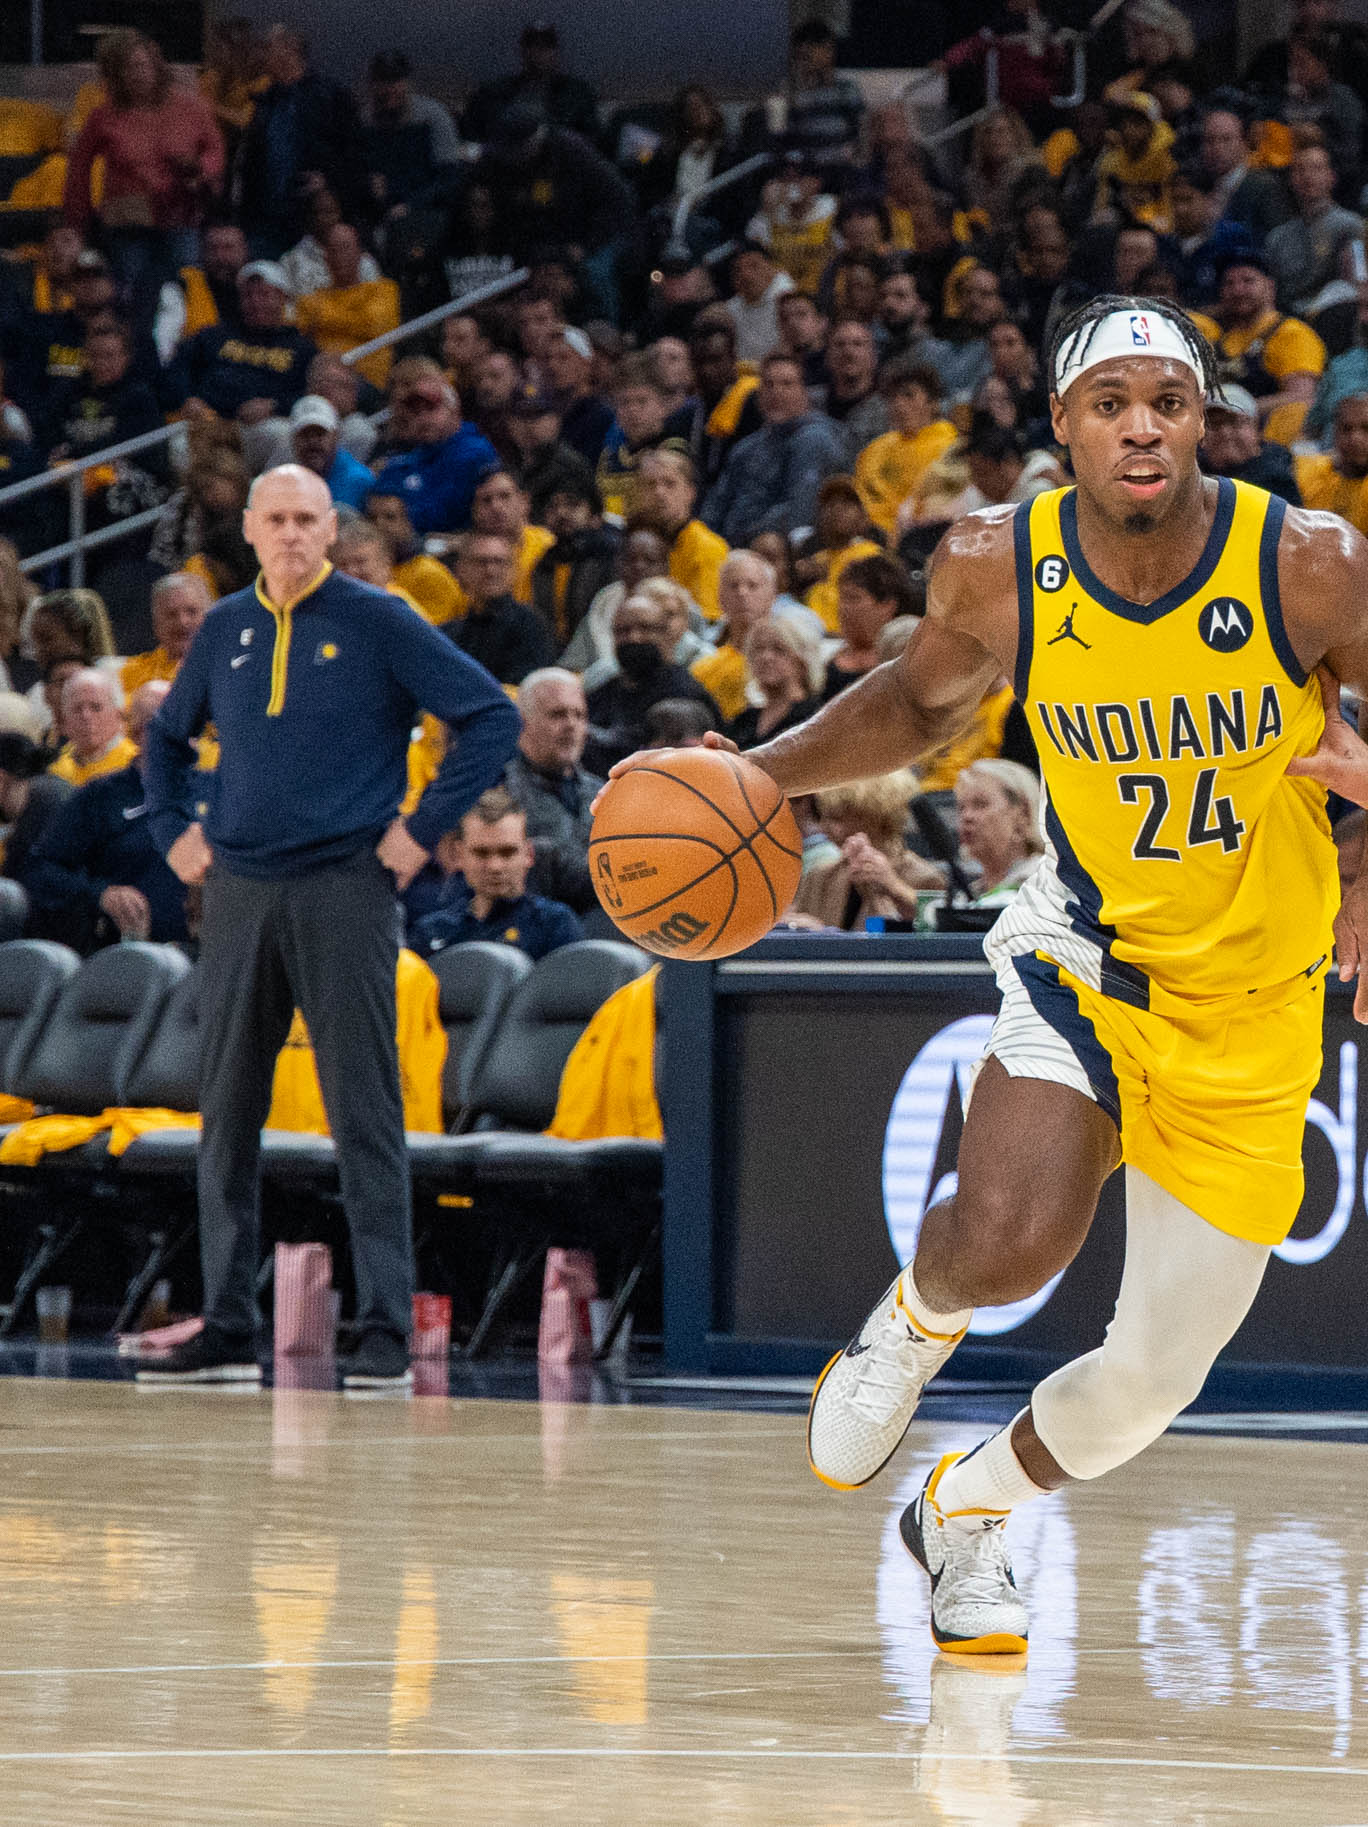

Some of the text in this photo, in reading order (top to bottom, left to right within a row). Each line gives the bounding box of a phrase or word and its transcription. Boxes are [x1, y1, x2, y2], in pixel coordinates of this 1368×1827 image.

[1041, 559, 1062, 589] 6
[1035, 684, 1283, 764] INDIANA
[1116, 766, 1247, 863] 24
